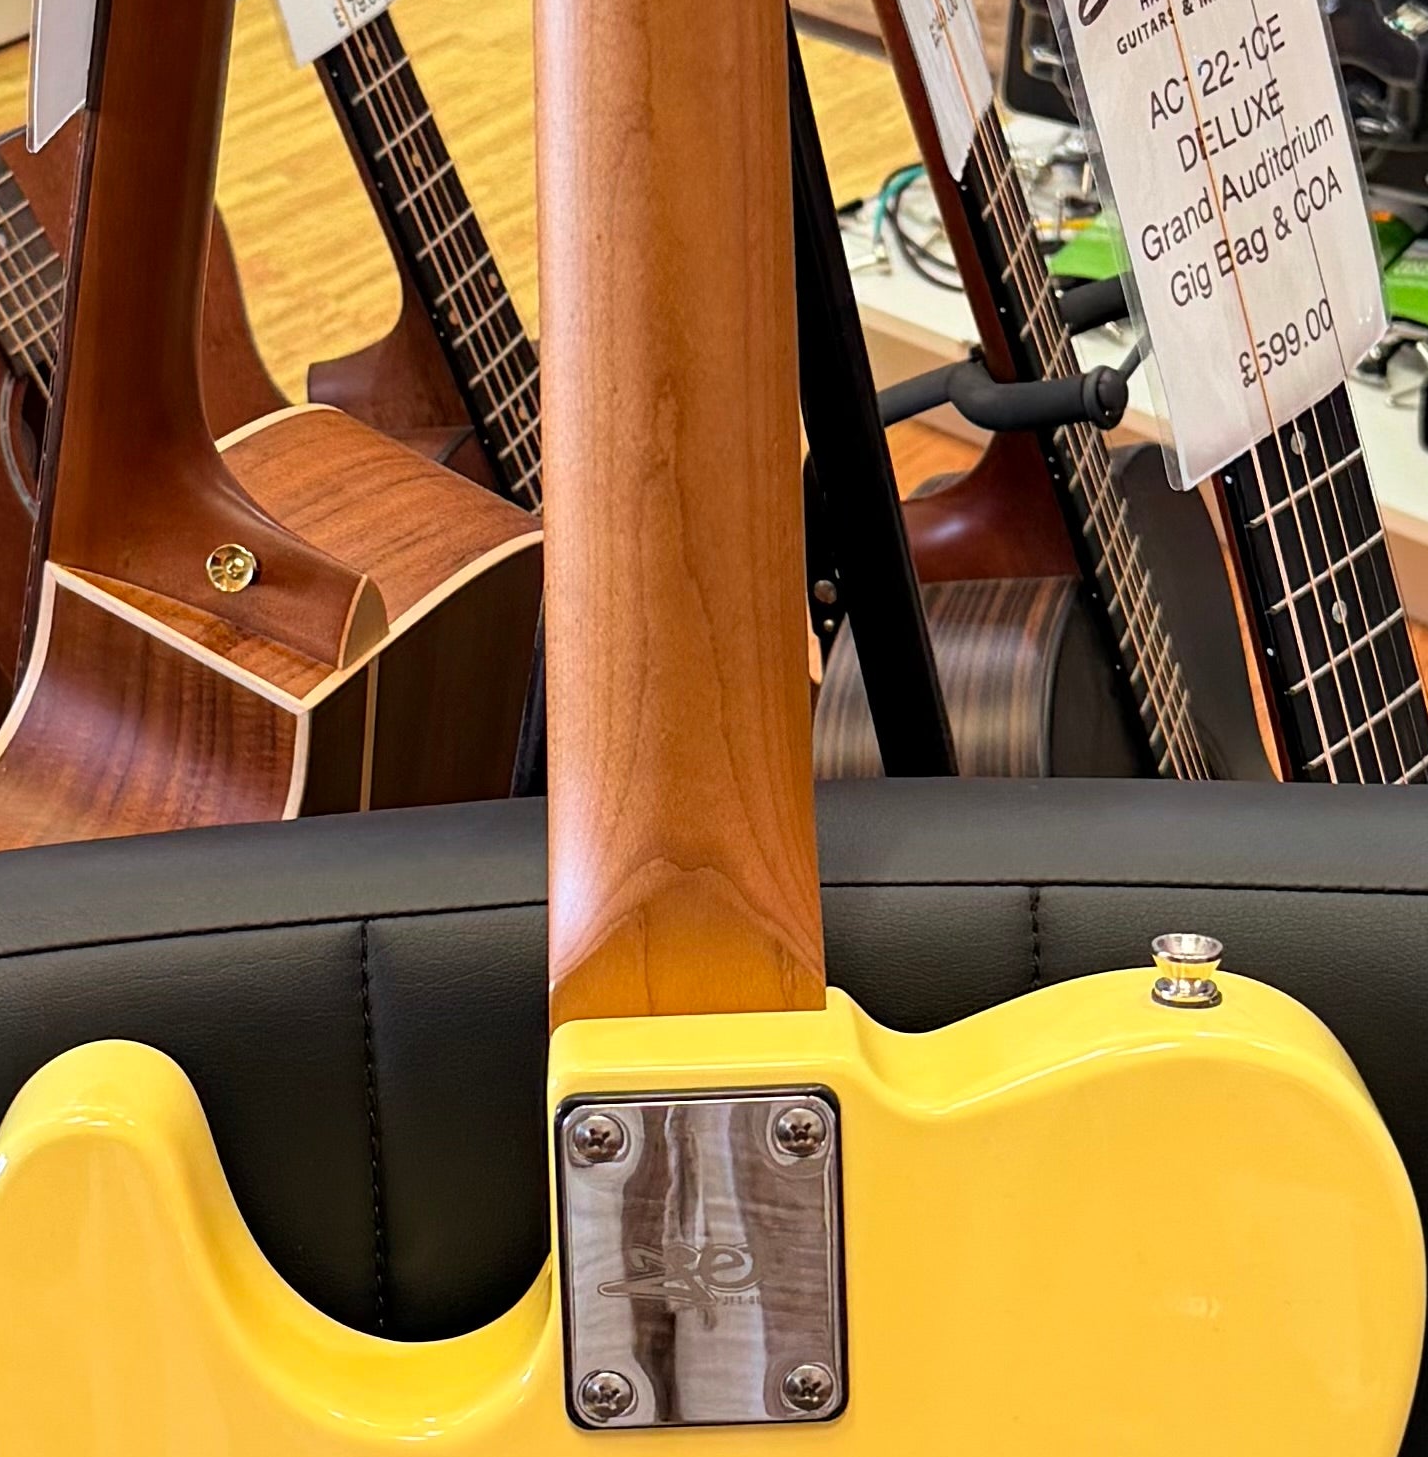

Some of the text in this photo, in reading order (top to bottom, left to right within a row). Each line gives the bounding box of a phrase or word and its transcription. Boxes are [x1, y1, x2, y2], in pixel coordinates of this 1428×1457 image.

[1116, 6, 1176, 56] GUITARS
[1177, 78, 1285, 173] DELUXE
[1140, 112, 1335, 262] Grand Auditorium
[1170, 165, 1343, 308] Gig Bag & COA
[1238, 296, 1335, 388] £599.00
